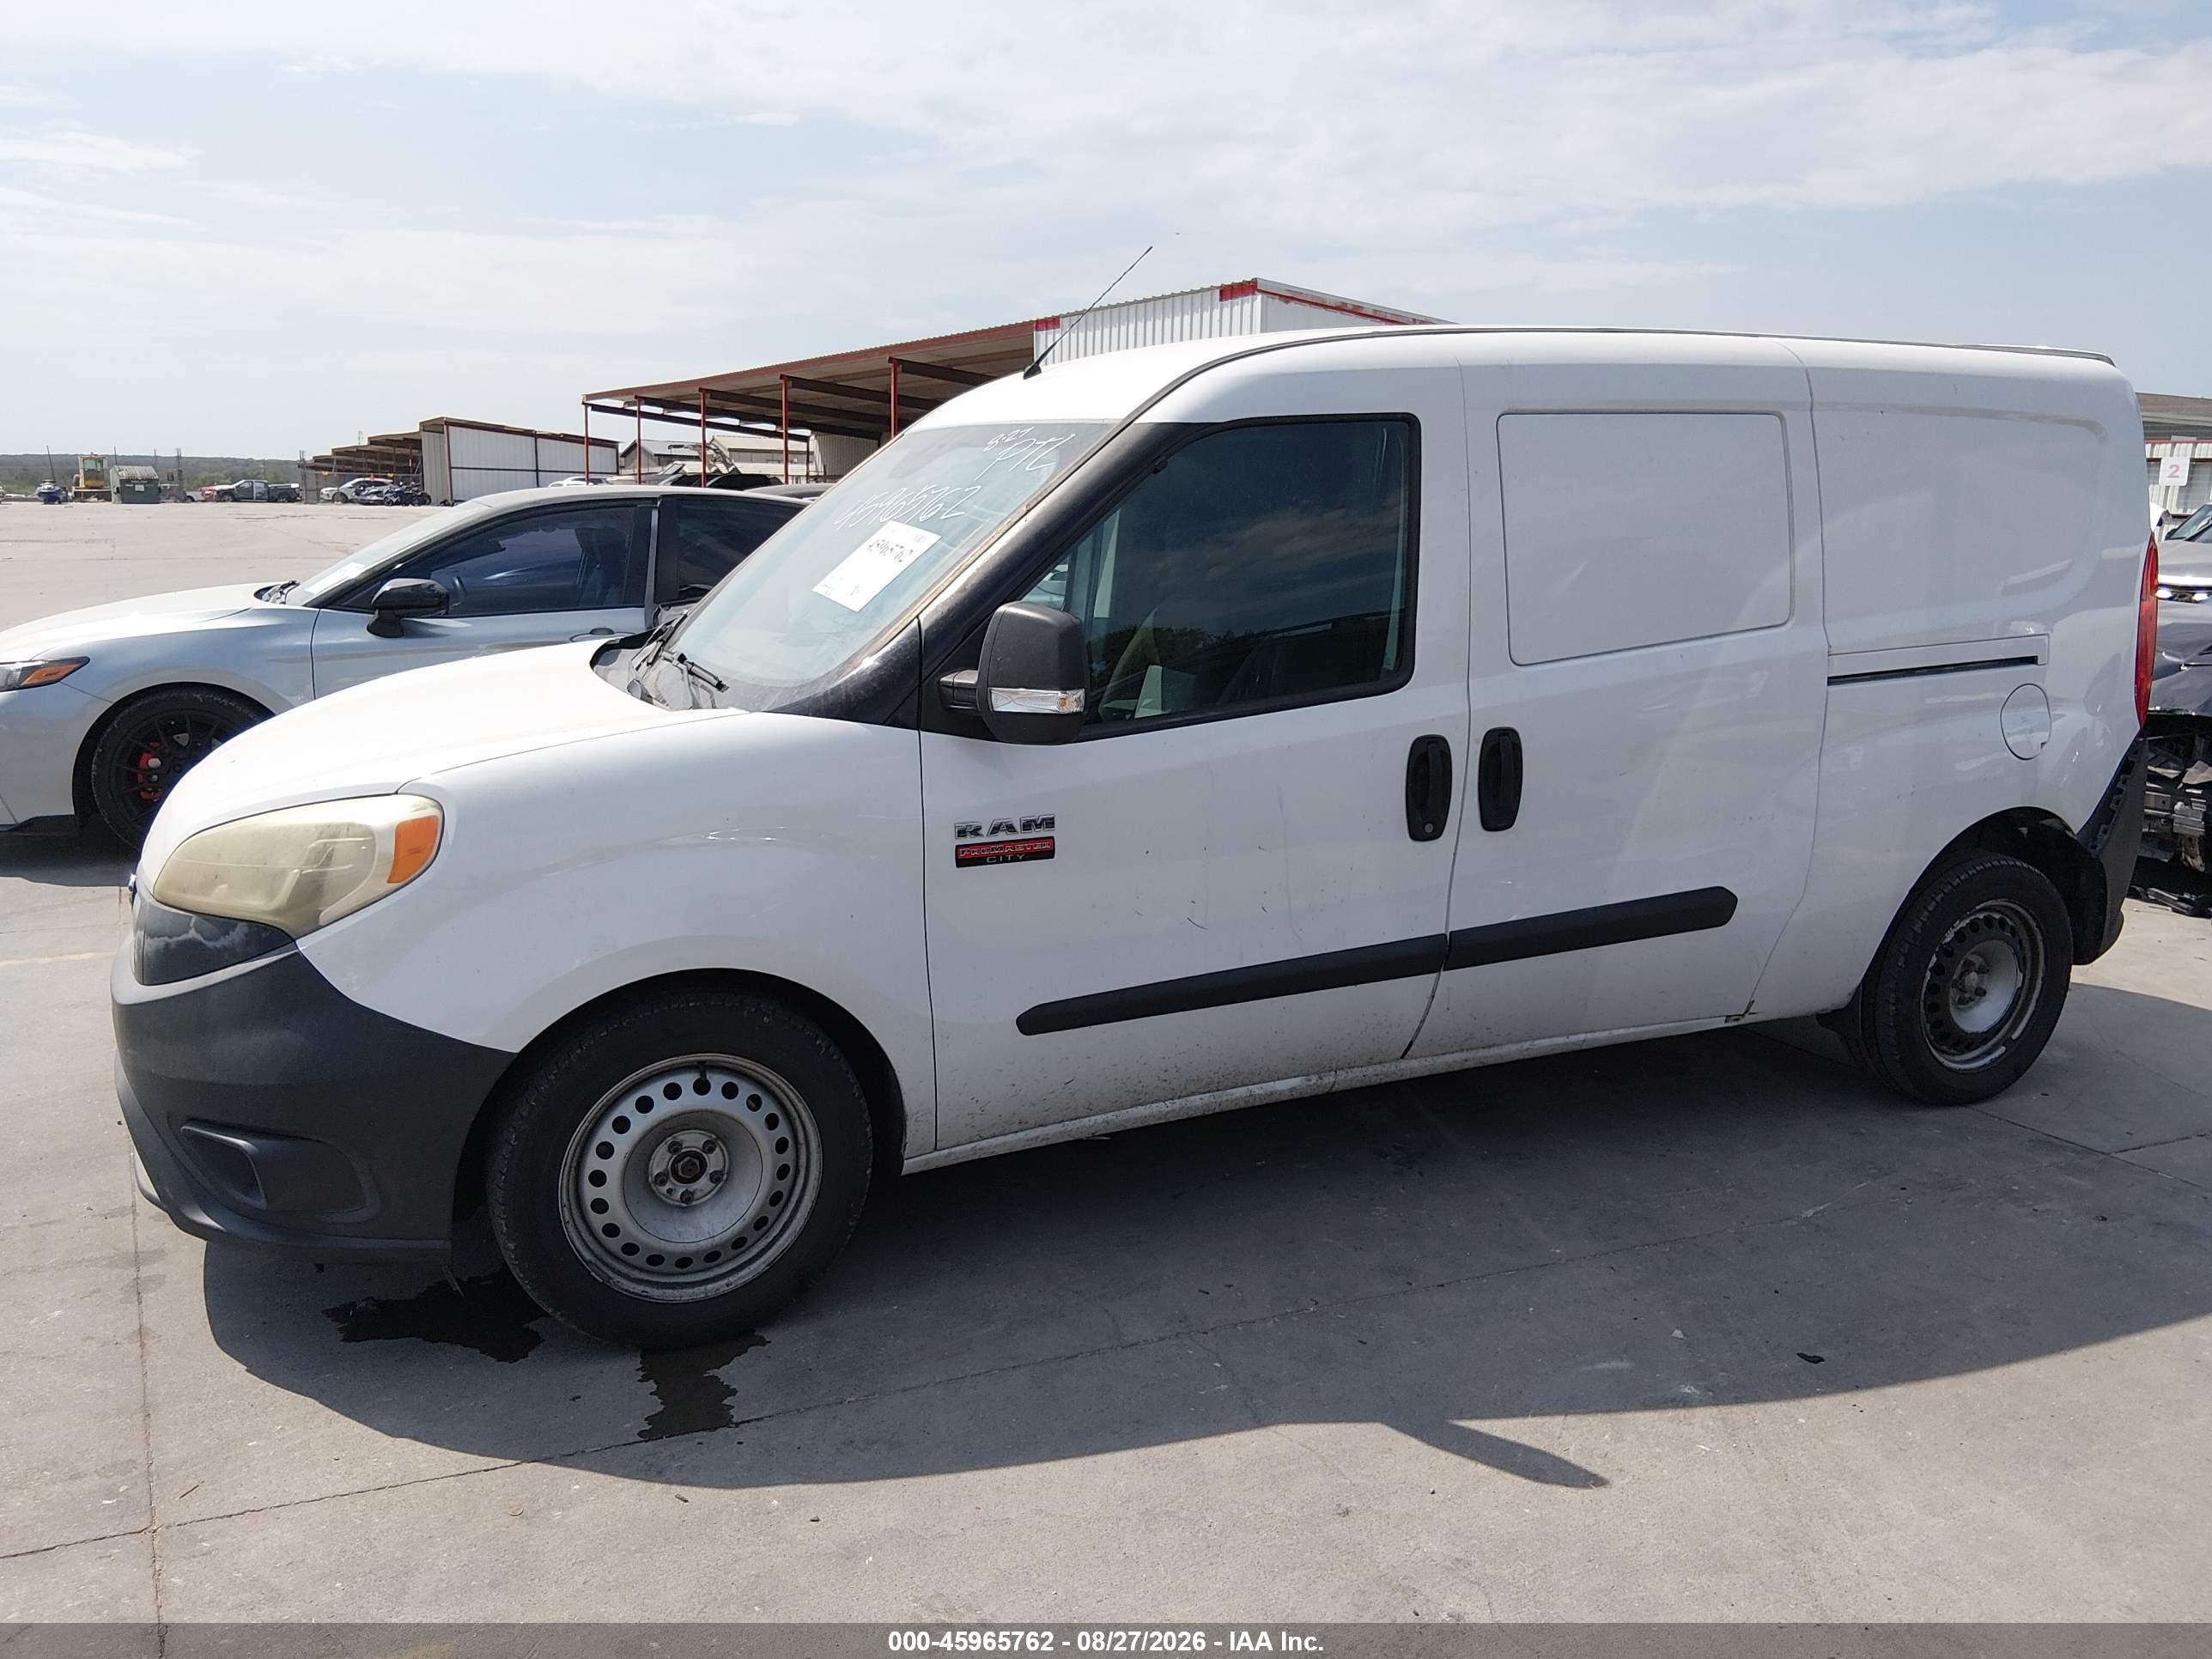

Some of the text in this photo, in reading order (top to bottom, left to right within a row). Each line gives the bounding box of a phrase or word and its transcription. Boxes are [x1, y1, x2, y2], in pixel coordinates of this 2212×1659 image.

[2167, 465, 2180, 478] 2
[834, 483, 982, 531] 45965762
[954, 813, 1055, 840] RAM
[986, 853, 1026, 864] CITY
